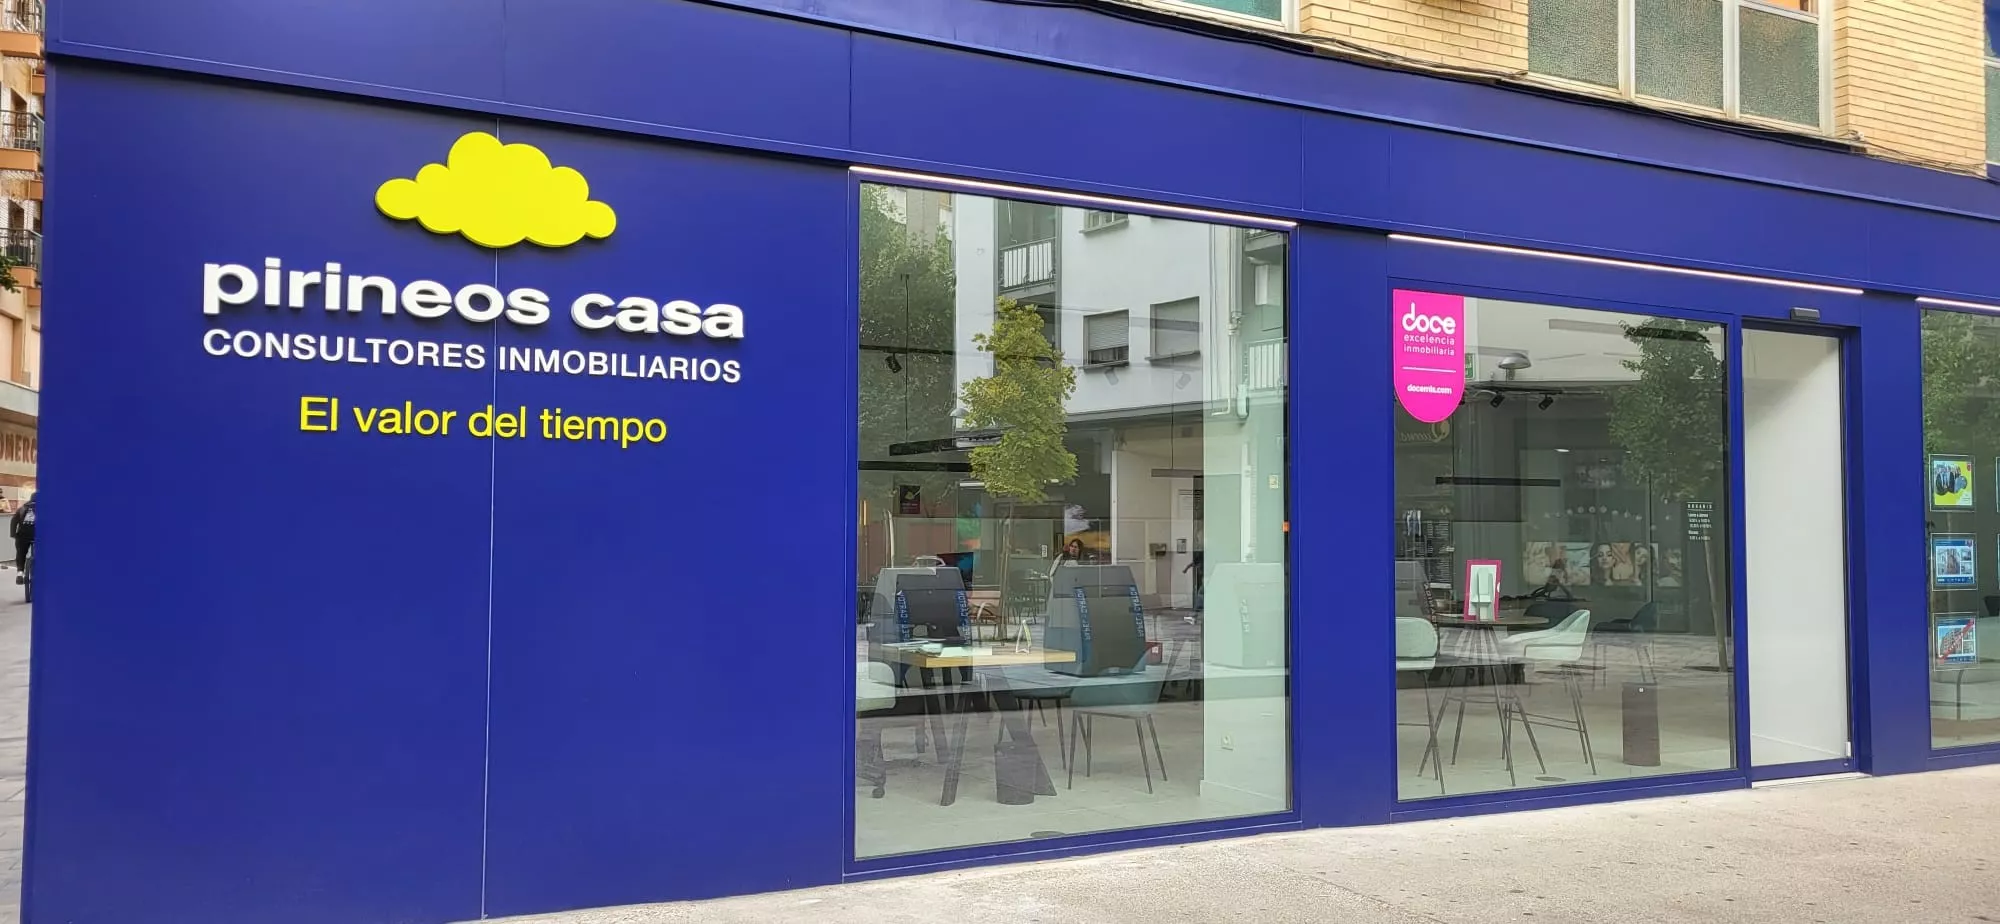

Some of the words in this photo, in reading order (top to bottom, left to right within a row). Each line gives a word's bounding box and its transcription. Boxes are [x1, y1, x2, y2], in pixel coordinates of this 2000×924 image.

[202, 256, 551, 327] pirineos
[570, 293, 744, 339] casa
[1402, 301, 1456, 335] doce
[202, 328, 486, 369] CONSULTORES
[498, 346, 741, 383] INMOBILIARIOS
[1403, 334, 1455, 346] excelencia
[1403, 344, 1455, 356] inmobiliaria
[299, 395, 338, 433] El
[353, 400, 456, 437] valor
[468, 404, 526, 439] del
[539, 407, 668, 449] tiempo
